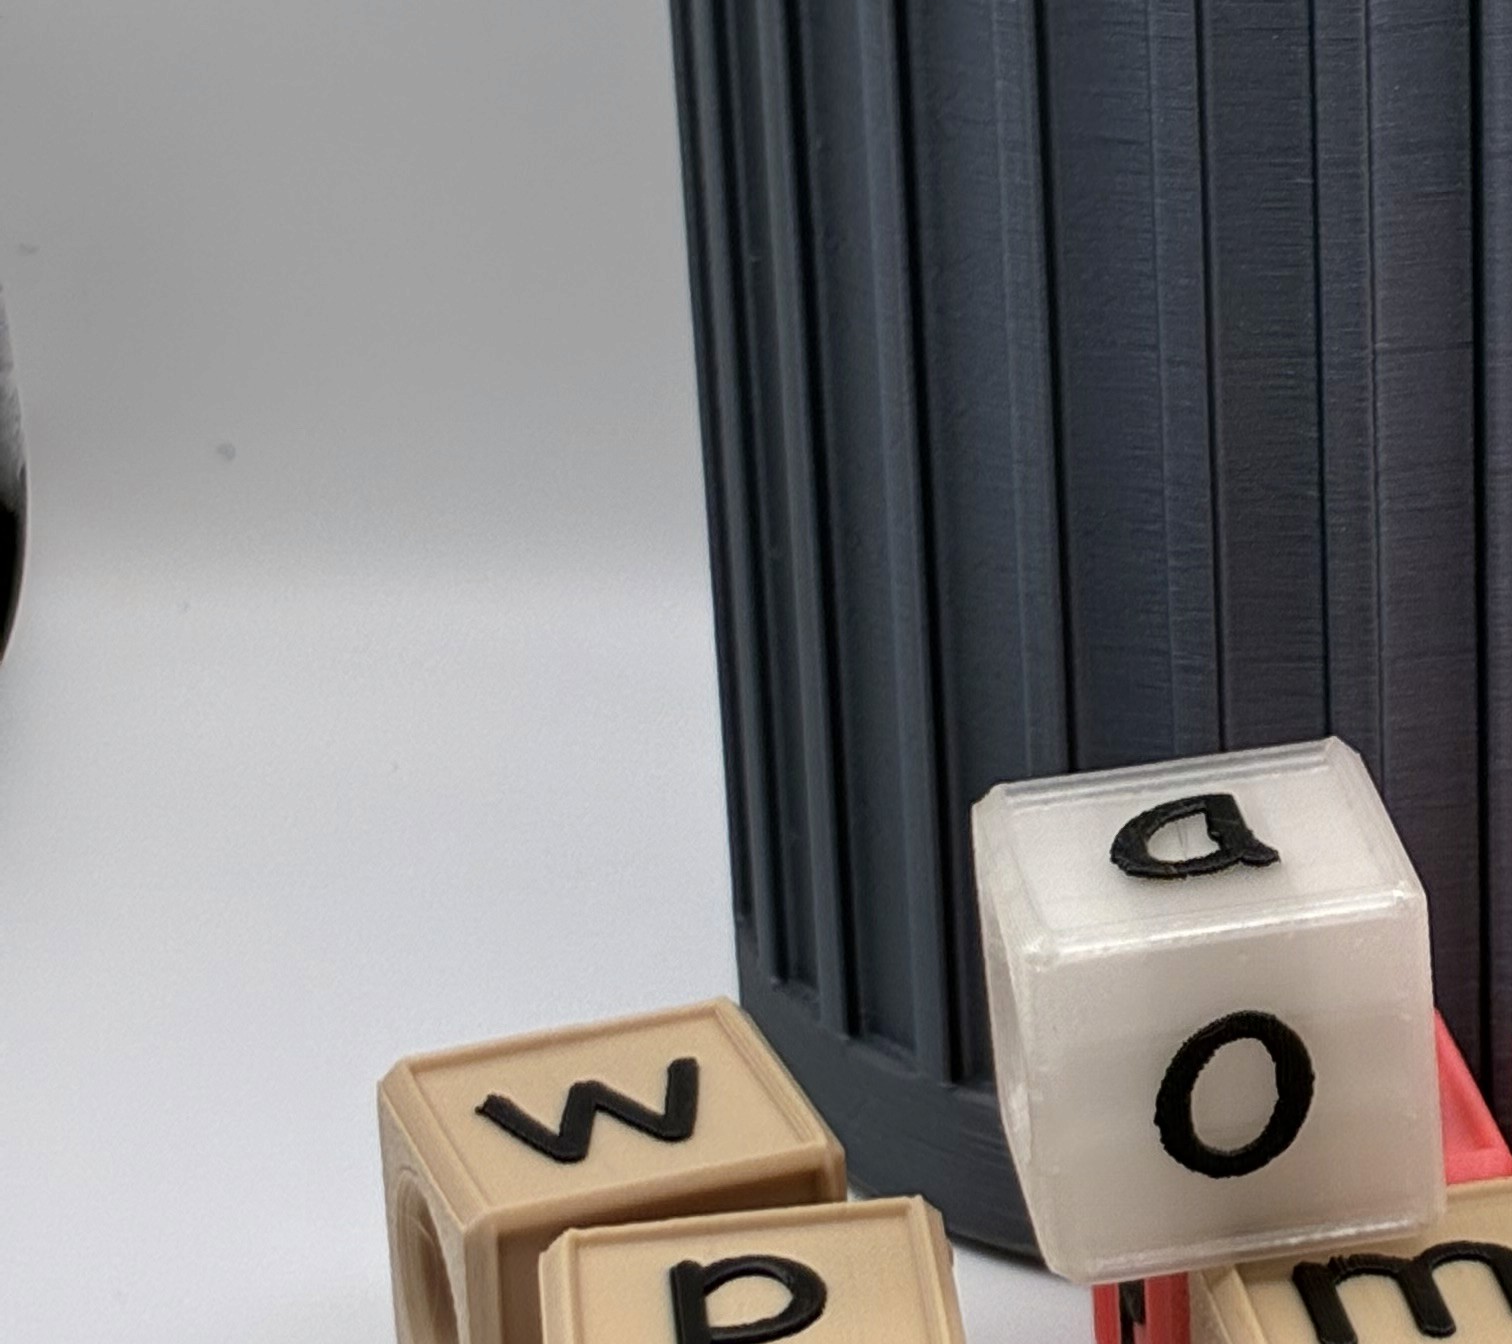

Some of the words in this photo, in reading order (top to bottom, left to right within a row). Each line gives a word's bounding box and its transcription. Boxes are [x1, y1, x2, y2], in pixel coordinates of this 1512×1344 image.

[1109, 792, 1280, 882] a
[474, 1057, 699, 1166] w
[1152, 1009, 1317, 1181] o
